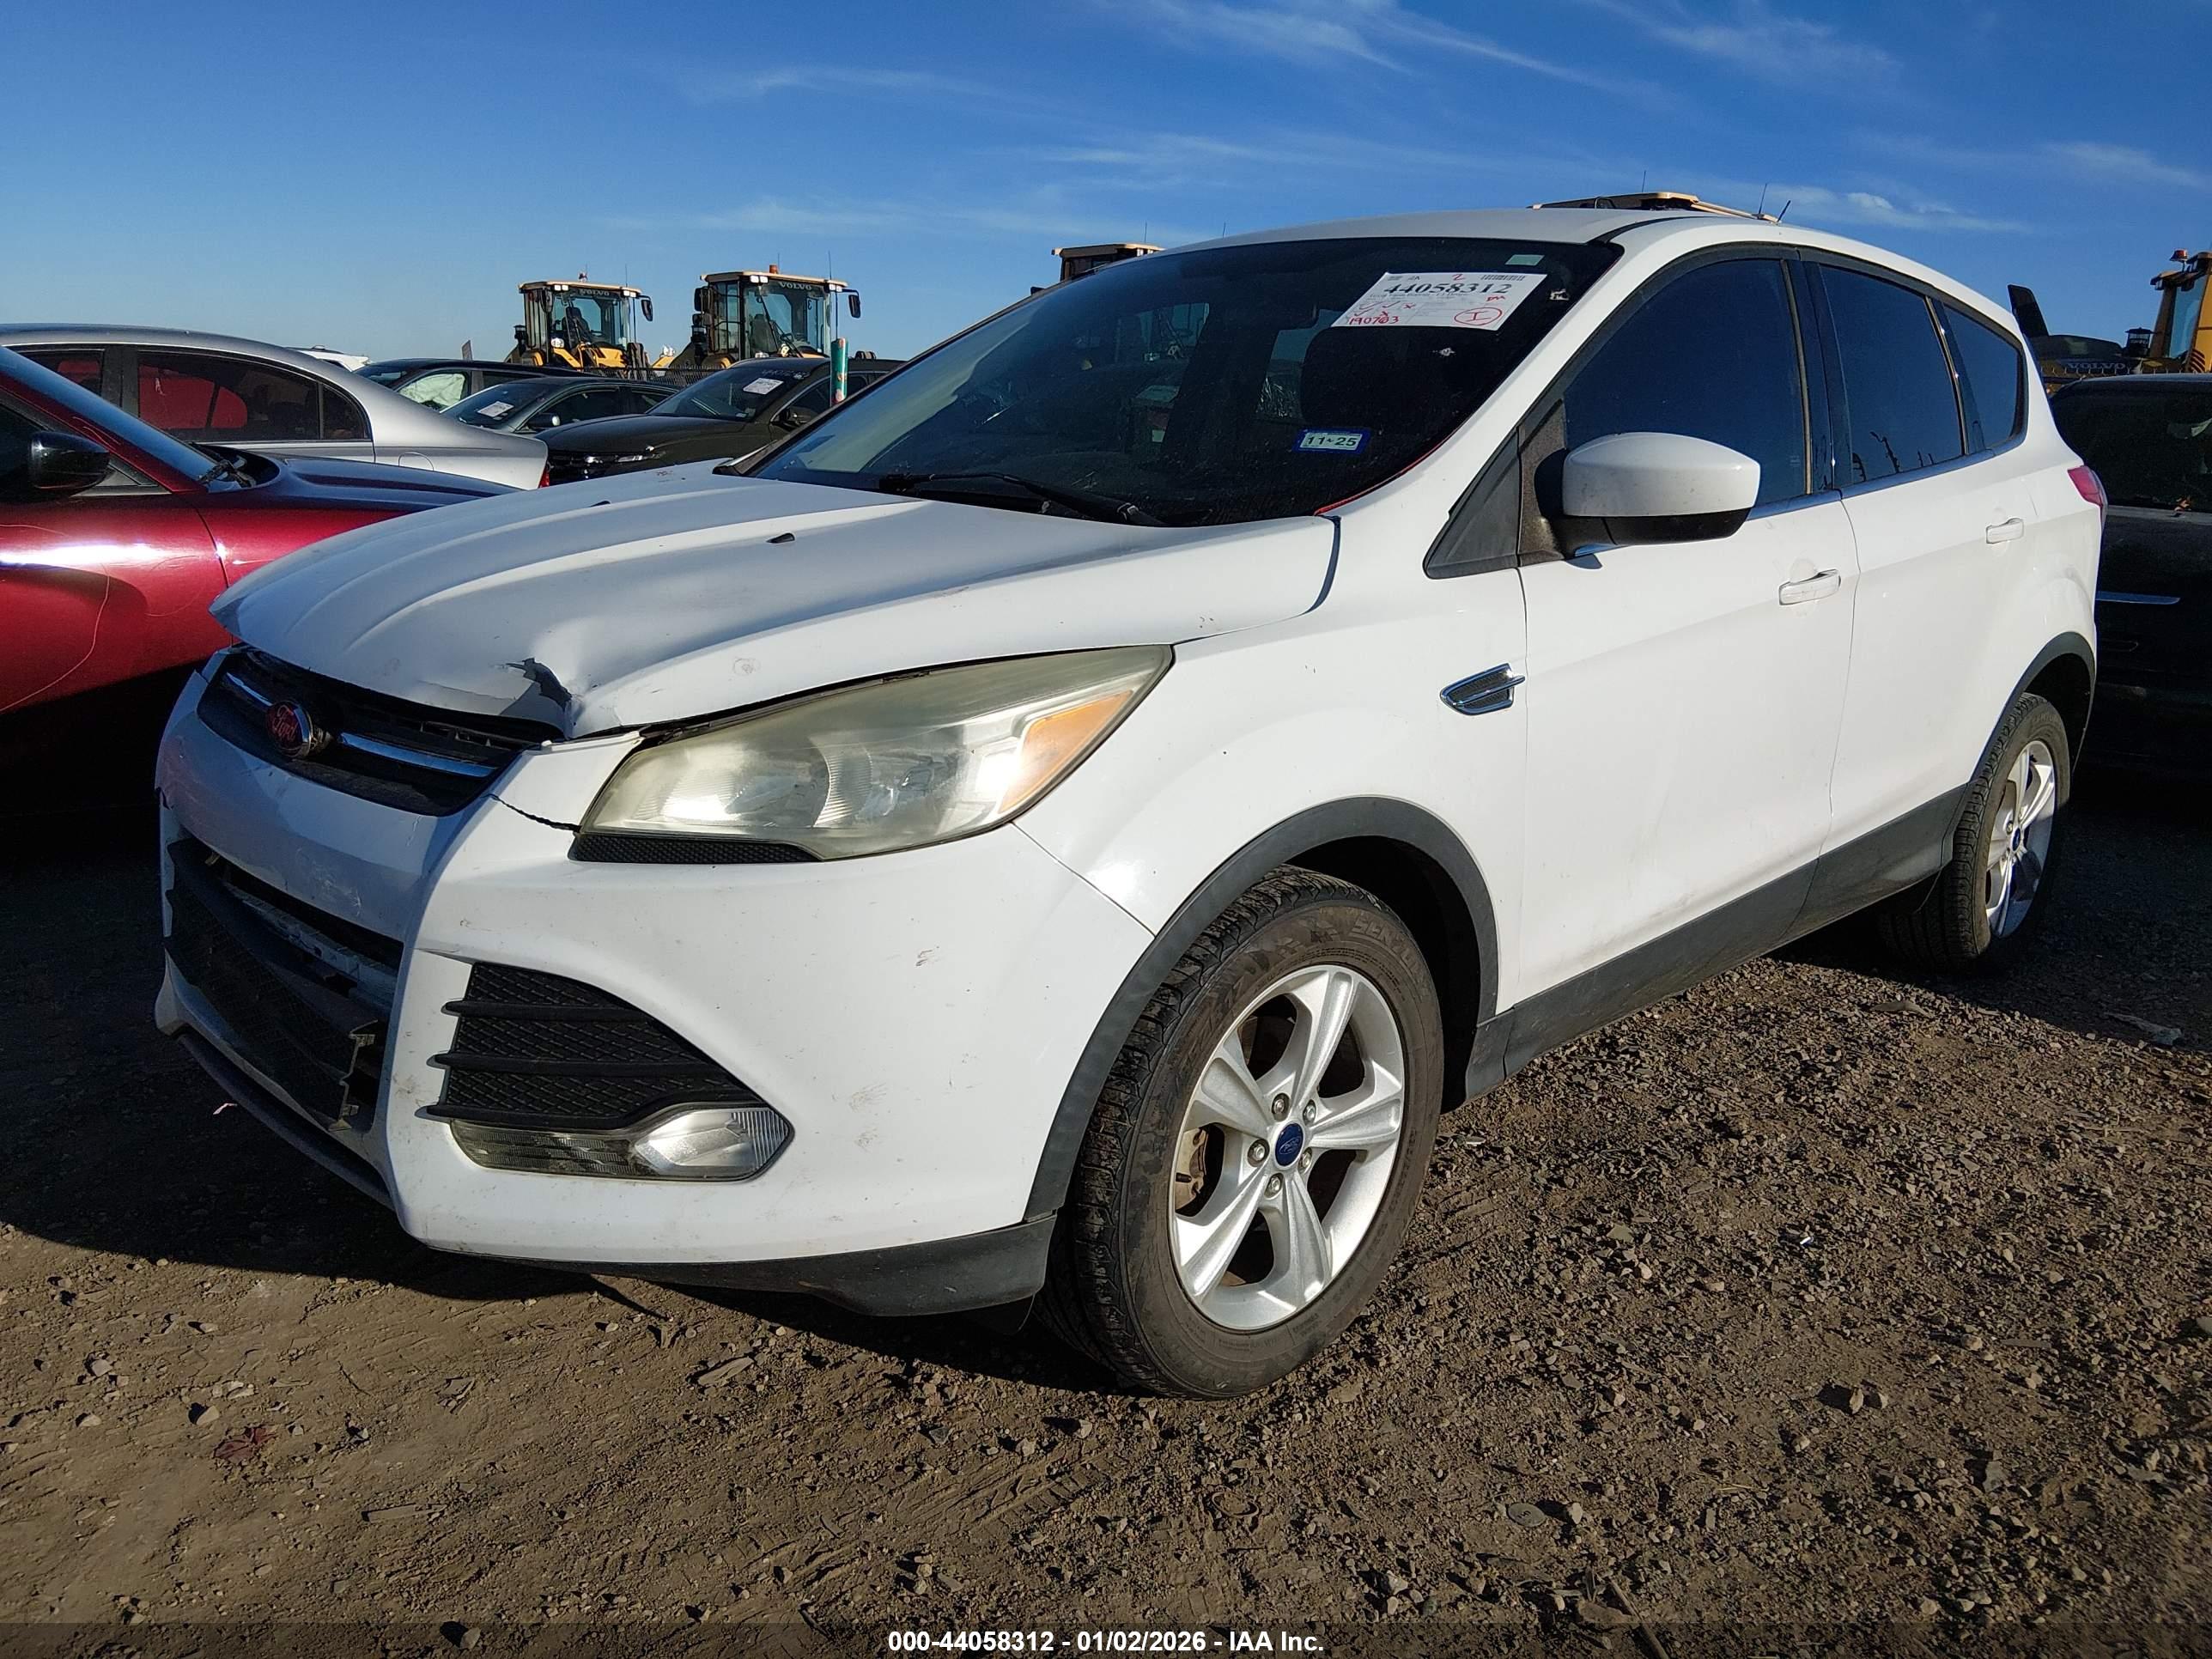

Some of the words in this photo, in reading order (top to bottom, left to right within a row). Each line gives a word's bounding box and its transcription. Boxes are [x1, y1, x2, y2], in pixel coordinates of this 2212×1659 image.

[778, 281, 812, 290] VOLVO
[1384, 283, 1512, 294] 44058312
[580, 288, 610, 296] VOLVO
[271, 704, 299, 740] Ford
